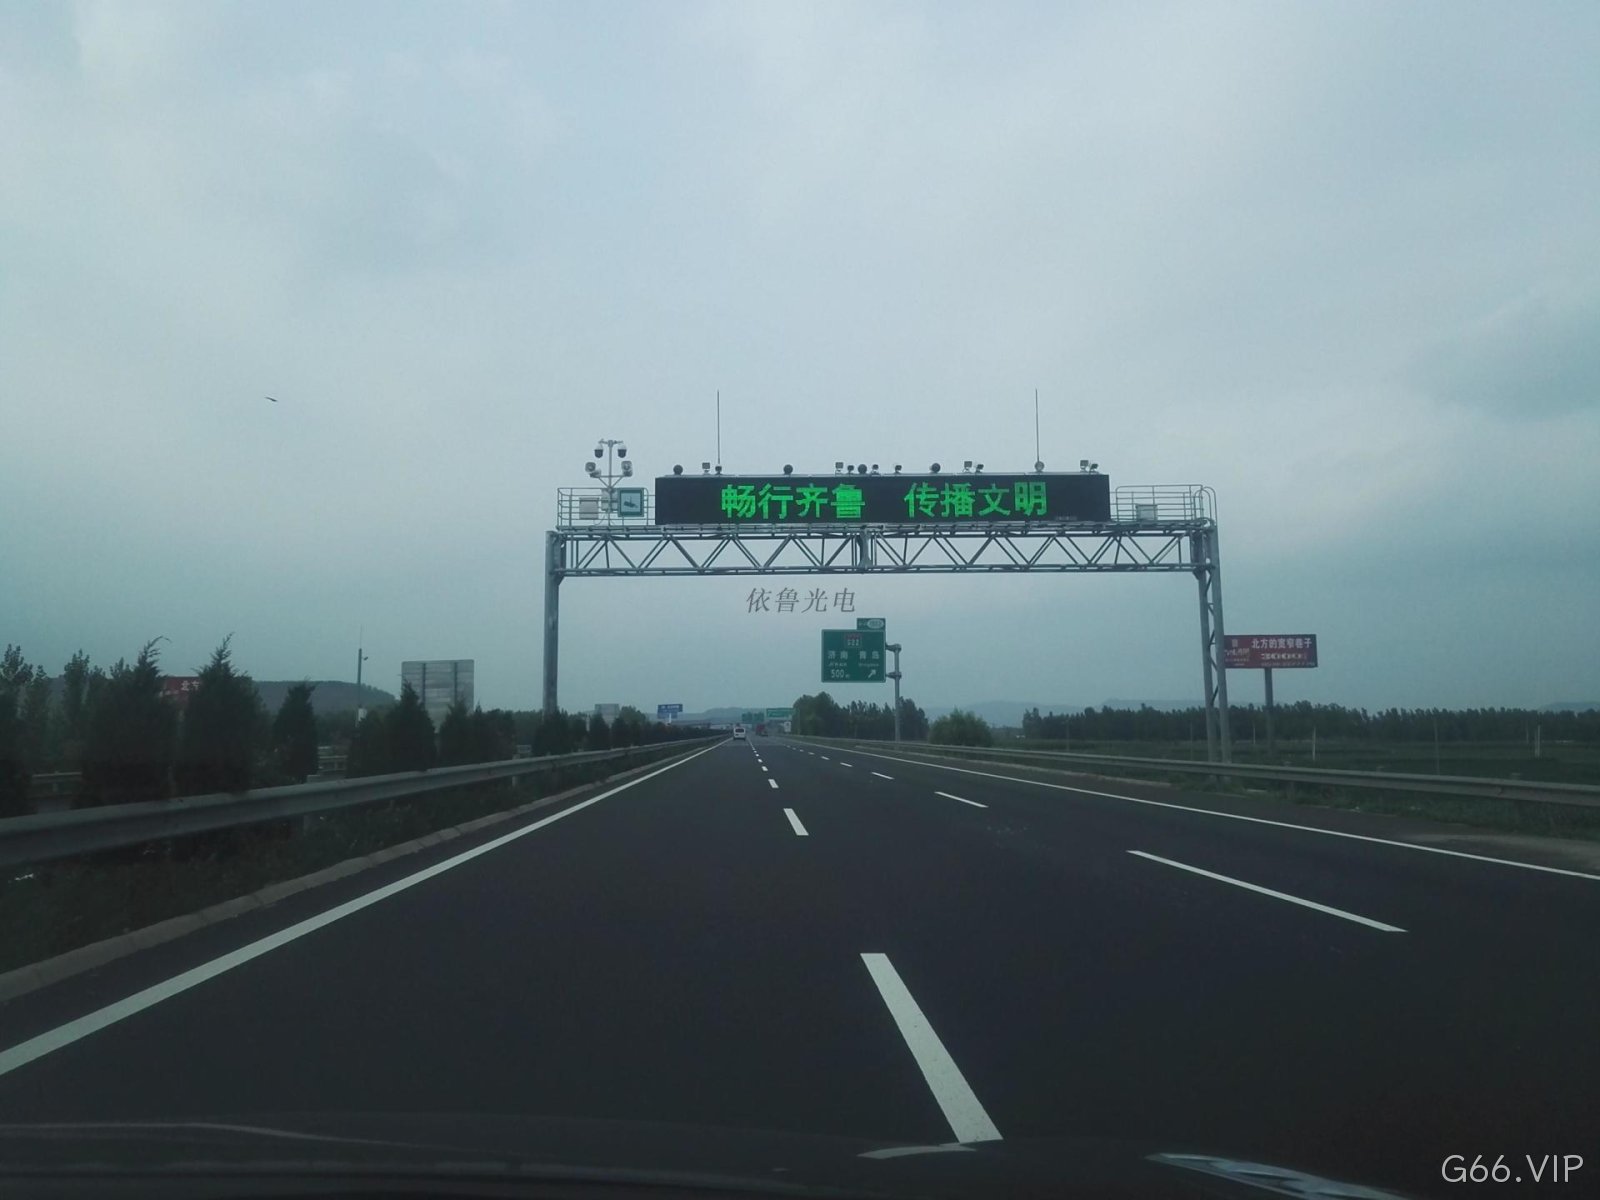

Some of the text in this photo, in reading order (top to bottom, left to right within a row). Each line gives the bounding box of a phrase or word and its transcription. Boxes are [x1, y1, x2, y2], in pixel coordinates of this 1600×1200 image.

[721, 481, 1048, 520] 畅行齐鲁 传播文明
